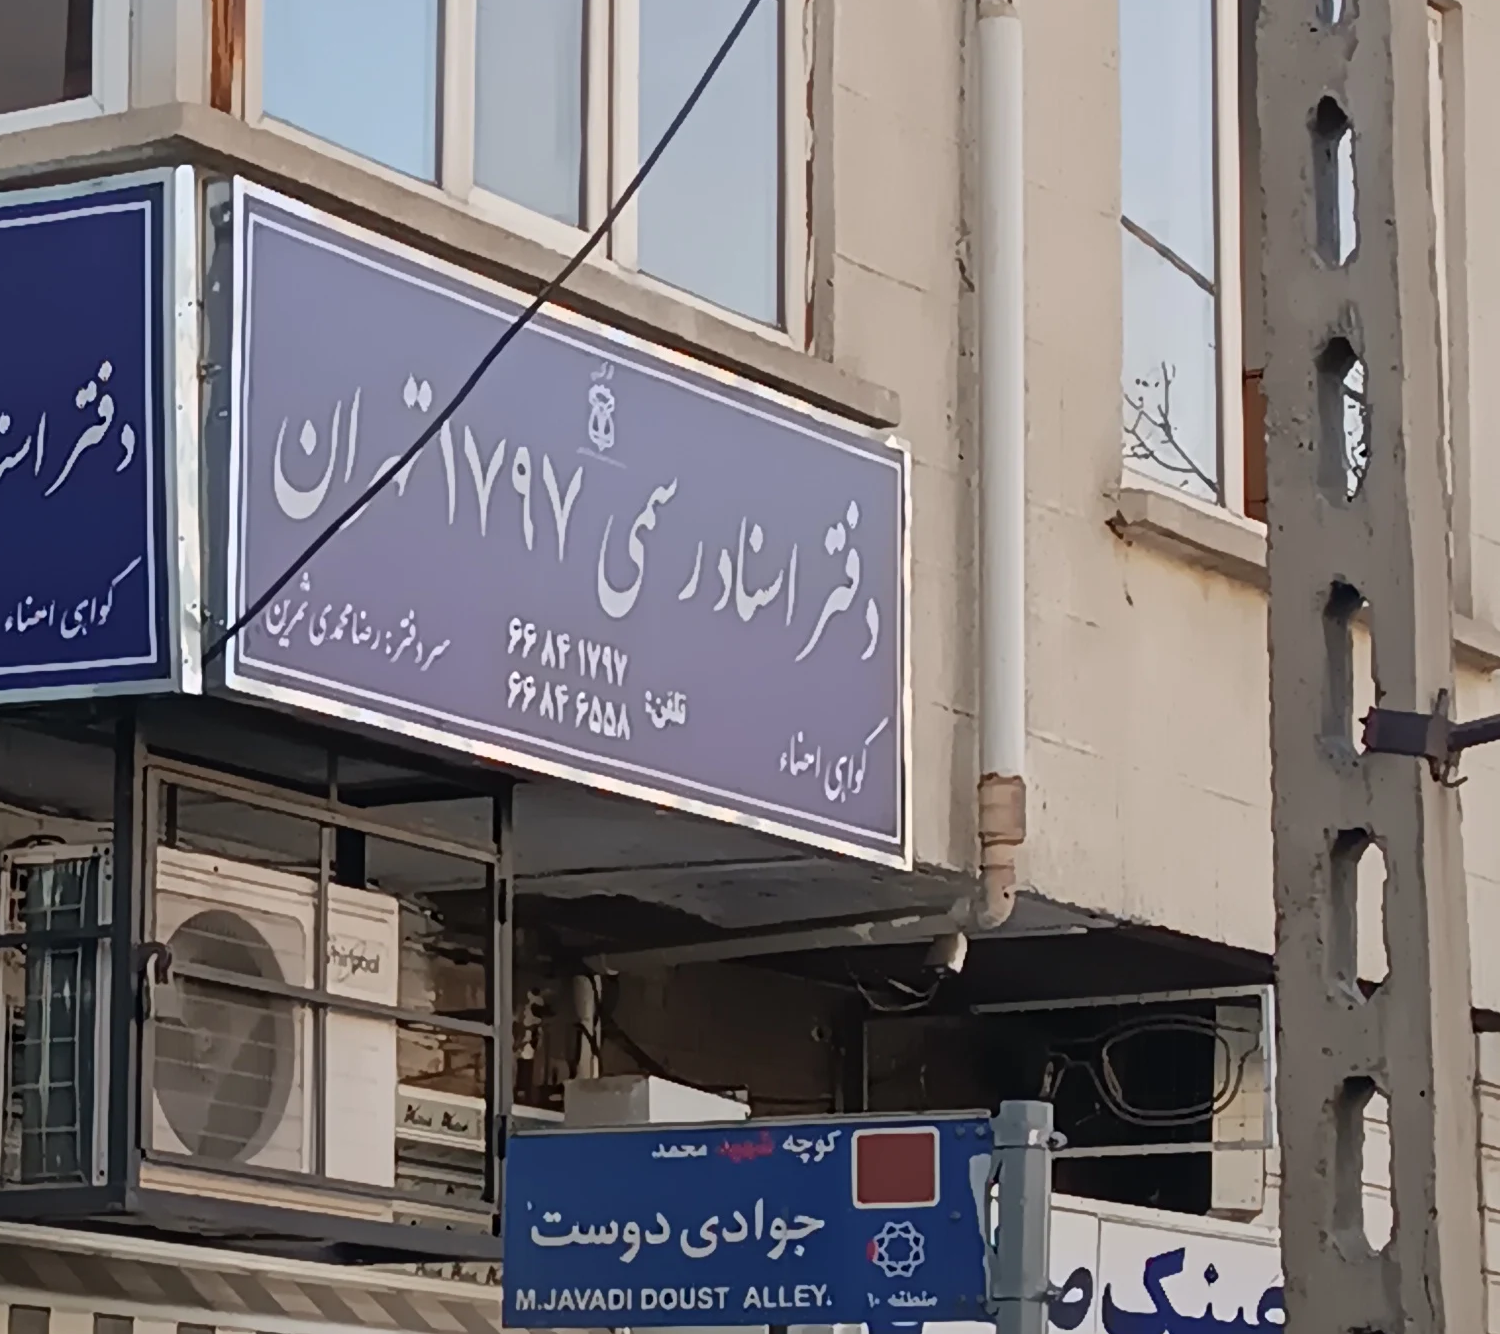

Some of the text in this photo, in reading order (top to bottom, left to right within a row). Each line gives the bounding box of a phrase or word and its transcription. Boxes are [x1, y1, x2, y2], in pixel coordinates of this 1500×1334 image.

[45, 360, 136, 497] دفتر
[273, 371, 880, 662] دفتر اسناد رسمی ۱۷۹۷ تهران
[651, 1142, 708, 1159] محمد
[782, 1129, 842, 1164] کوچه
[529, 1197, 826, 1263] جوادی دوست
[514, 1287, 633, 1312] M.JAVADI
[640, 1285, 731, 1311] DOUST
[886, 1290, 938, 1308] منطقه
